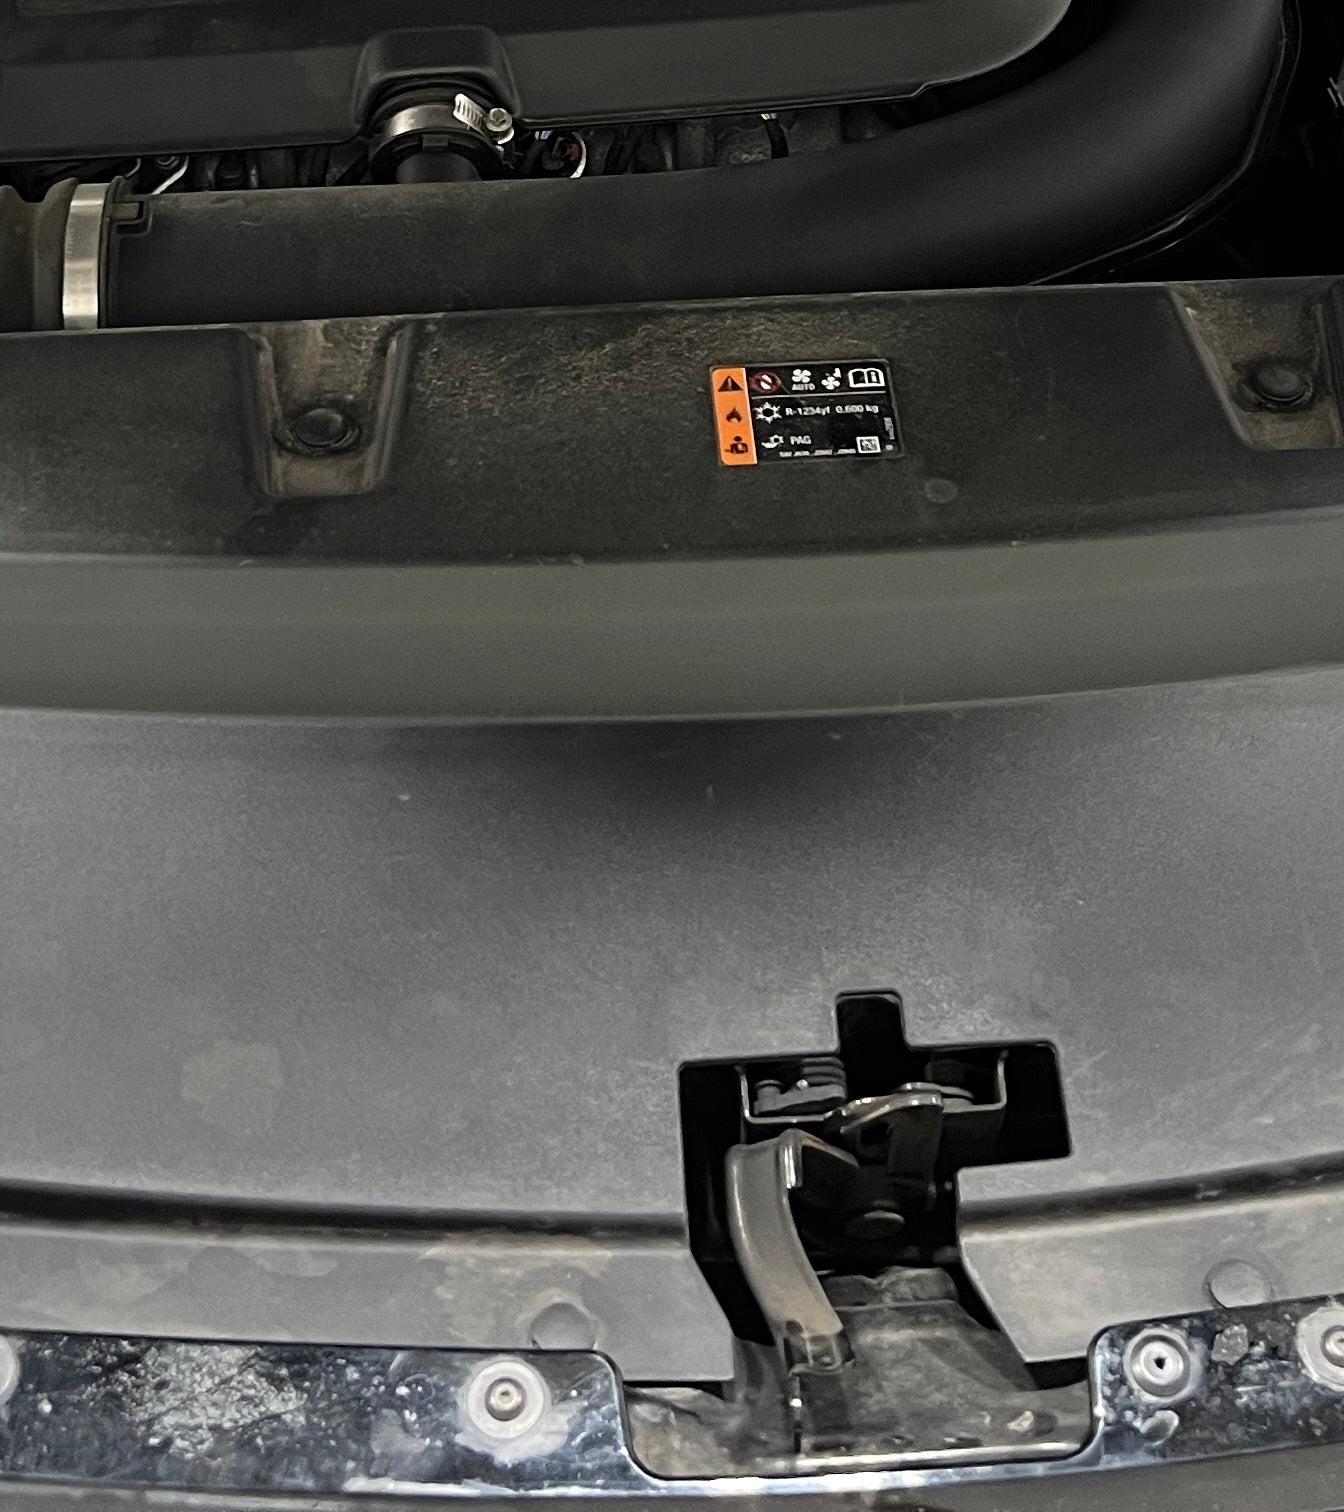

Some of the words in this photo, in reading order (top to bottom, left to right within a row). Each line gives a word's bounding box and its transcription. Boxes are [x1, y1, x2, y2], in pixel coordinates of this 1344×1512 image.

[791, 382, 816, 391] AUTO
[865, 404, 879, 414] kg
[790, 434, 812, 445] PAG
